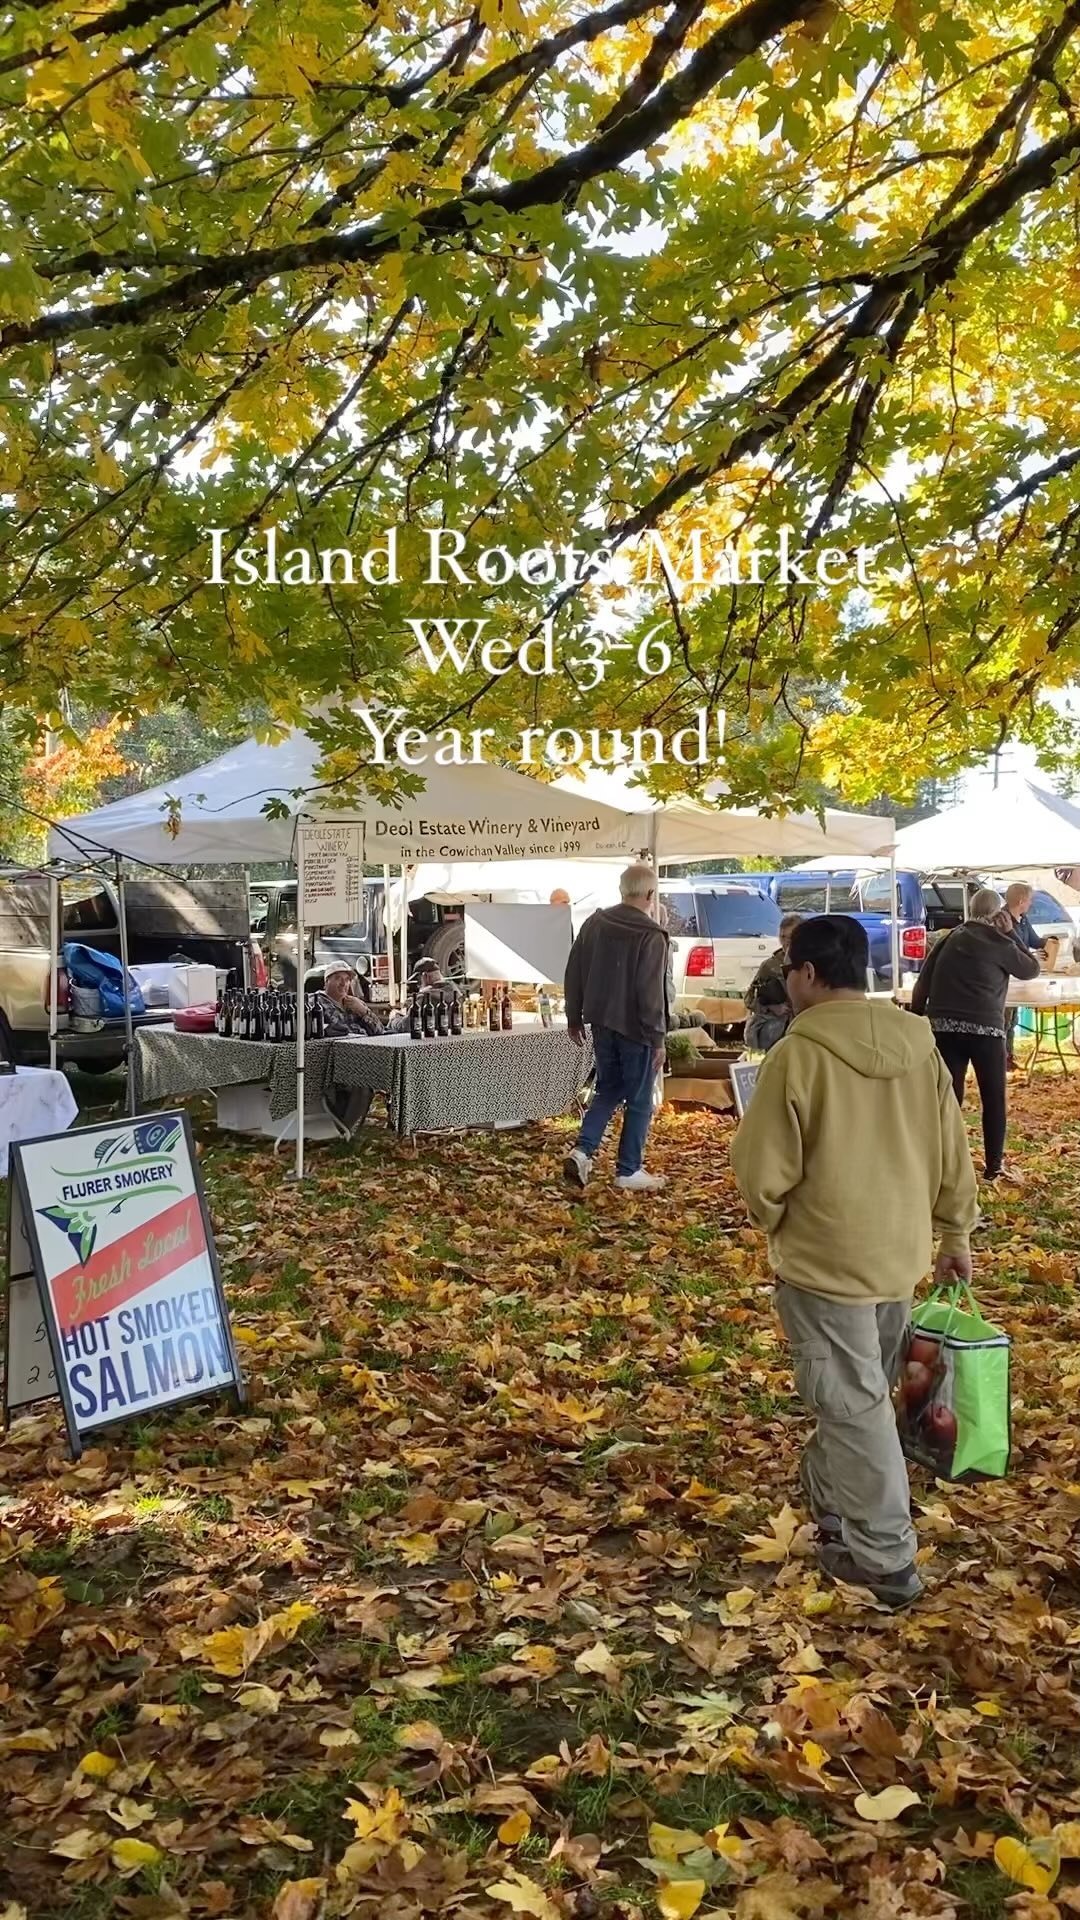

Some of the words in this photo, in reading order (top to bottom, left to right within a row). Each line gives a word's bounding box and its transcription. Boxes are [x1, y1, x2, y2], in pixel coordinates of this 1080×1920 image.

[375, 820, 413, 836] Deol
[419, 820, 466, 836] Estate
[468, 817, 523, 837] Winery
[527, 818, 538, 834] &
[540, 816, 601, 836] Vineyard
[316, 841, 349, 852] WINERY
[400, 848, 412, 858] in
[416, 845, 435, 857] the
[439, 844, 493, 857] Cowichan
[495, 842, 525, 857] Valley
[529, 842, 556, 854] since
[559, 840, 581, 853] 1999
[62, 1177, 112, 1201] FLURER
[114, 1163, 174, 1189] SMOKERY
[69, 1250, 131, 1320] Fresh
[138, 1210, 192, 1270] Local
[63, 1315, 110, 1362] HOT
[117, 1287, 218, 1345] SMOKED
[68, 1324, 231, 1418] SALMON
